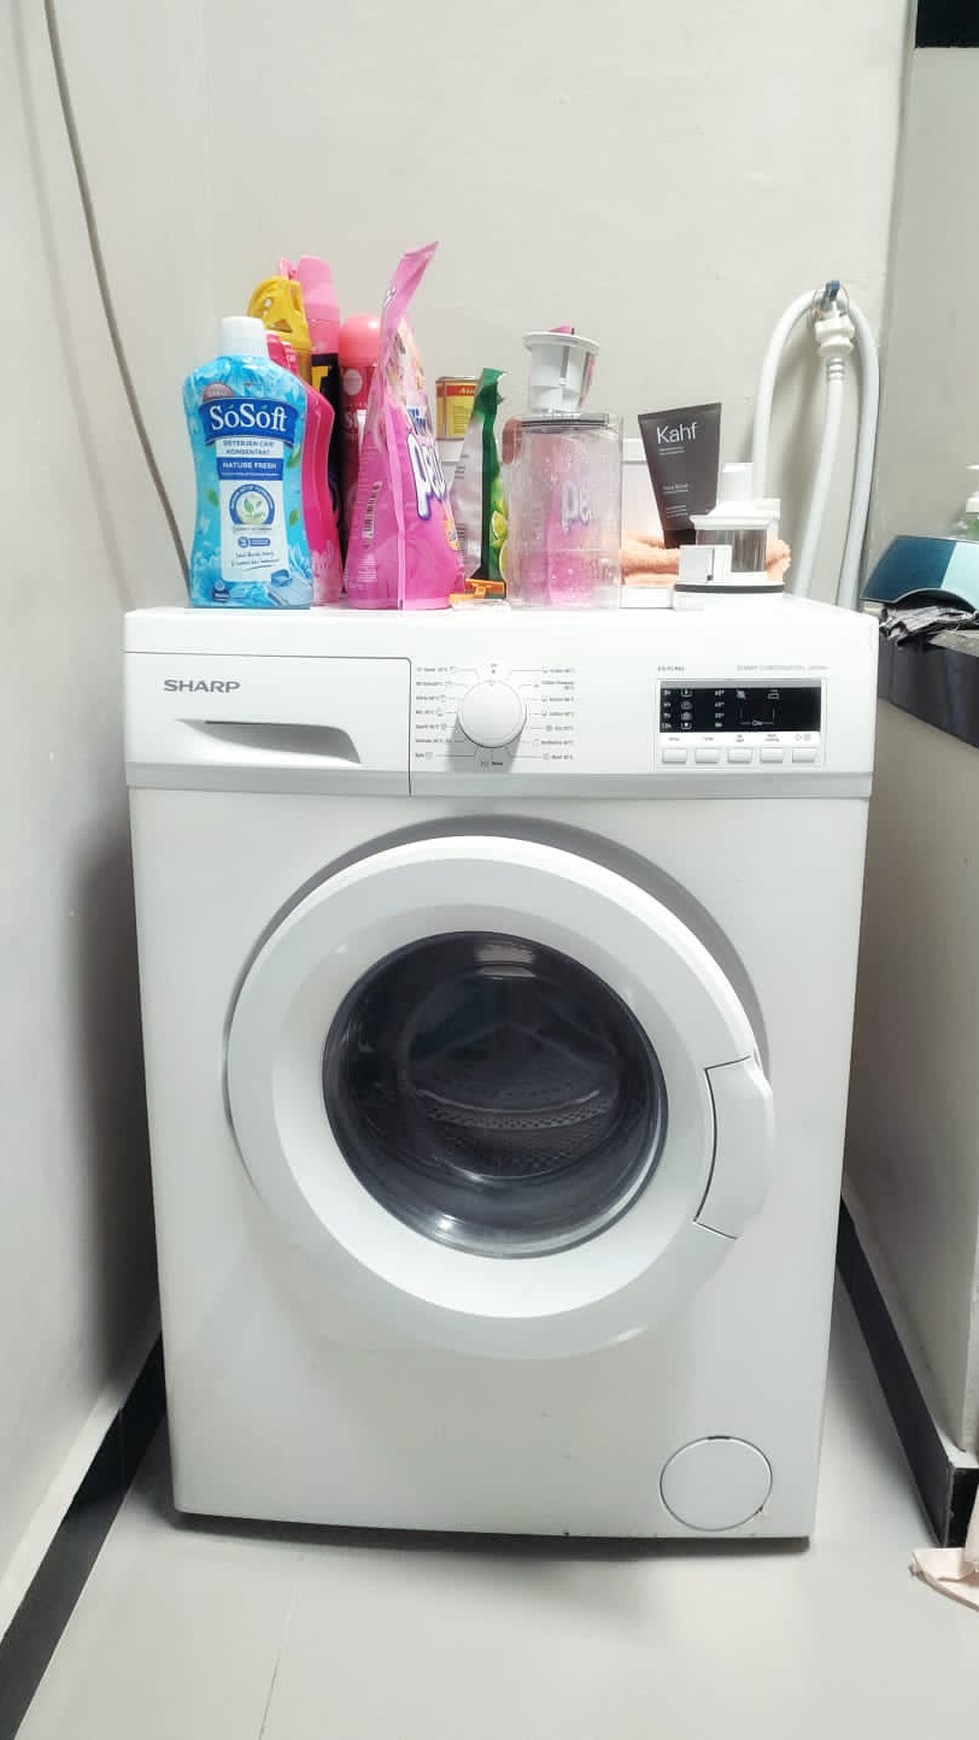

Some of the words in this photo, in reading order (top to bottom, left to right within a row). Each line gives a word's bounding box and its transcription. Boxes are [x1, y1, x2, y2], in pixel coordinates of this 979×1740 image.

[656, 421, 698, 445] Kahf
[222, 461, 253, 470] NATURE
[254, 461, 277, 470] FRESH
[163, 679, 241, 694] SHARP
